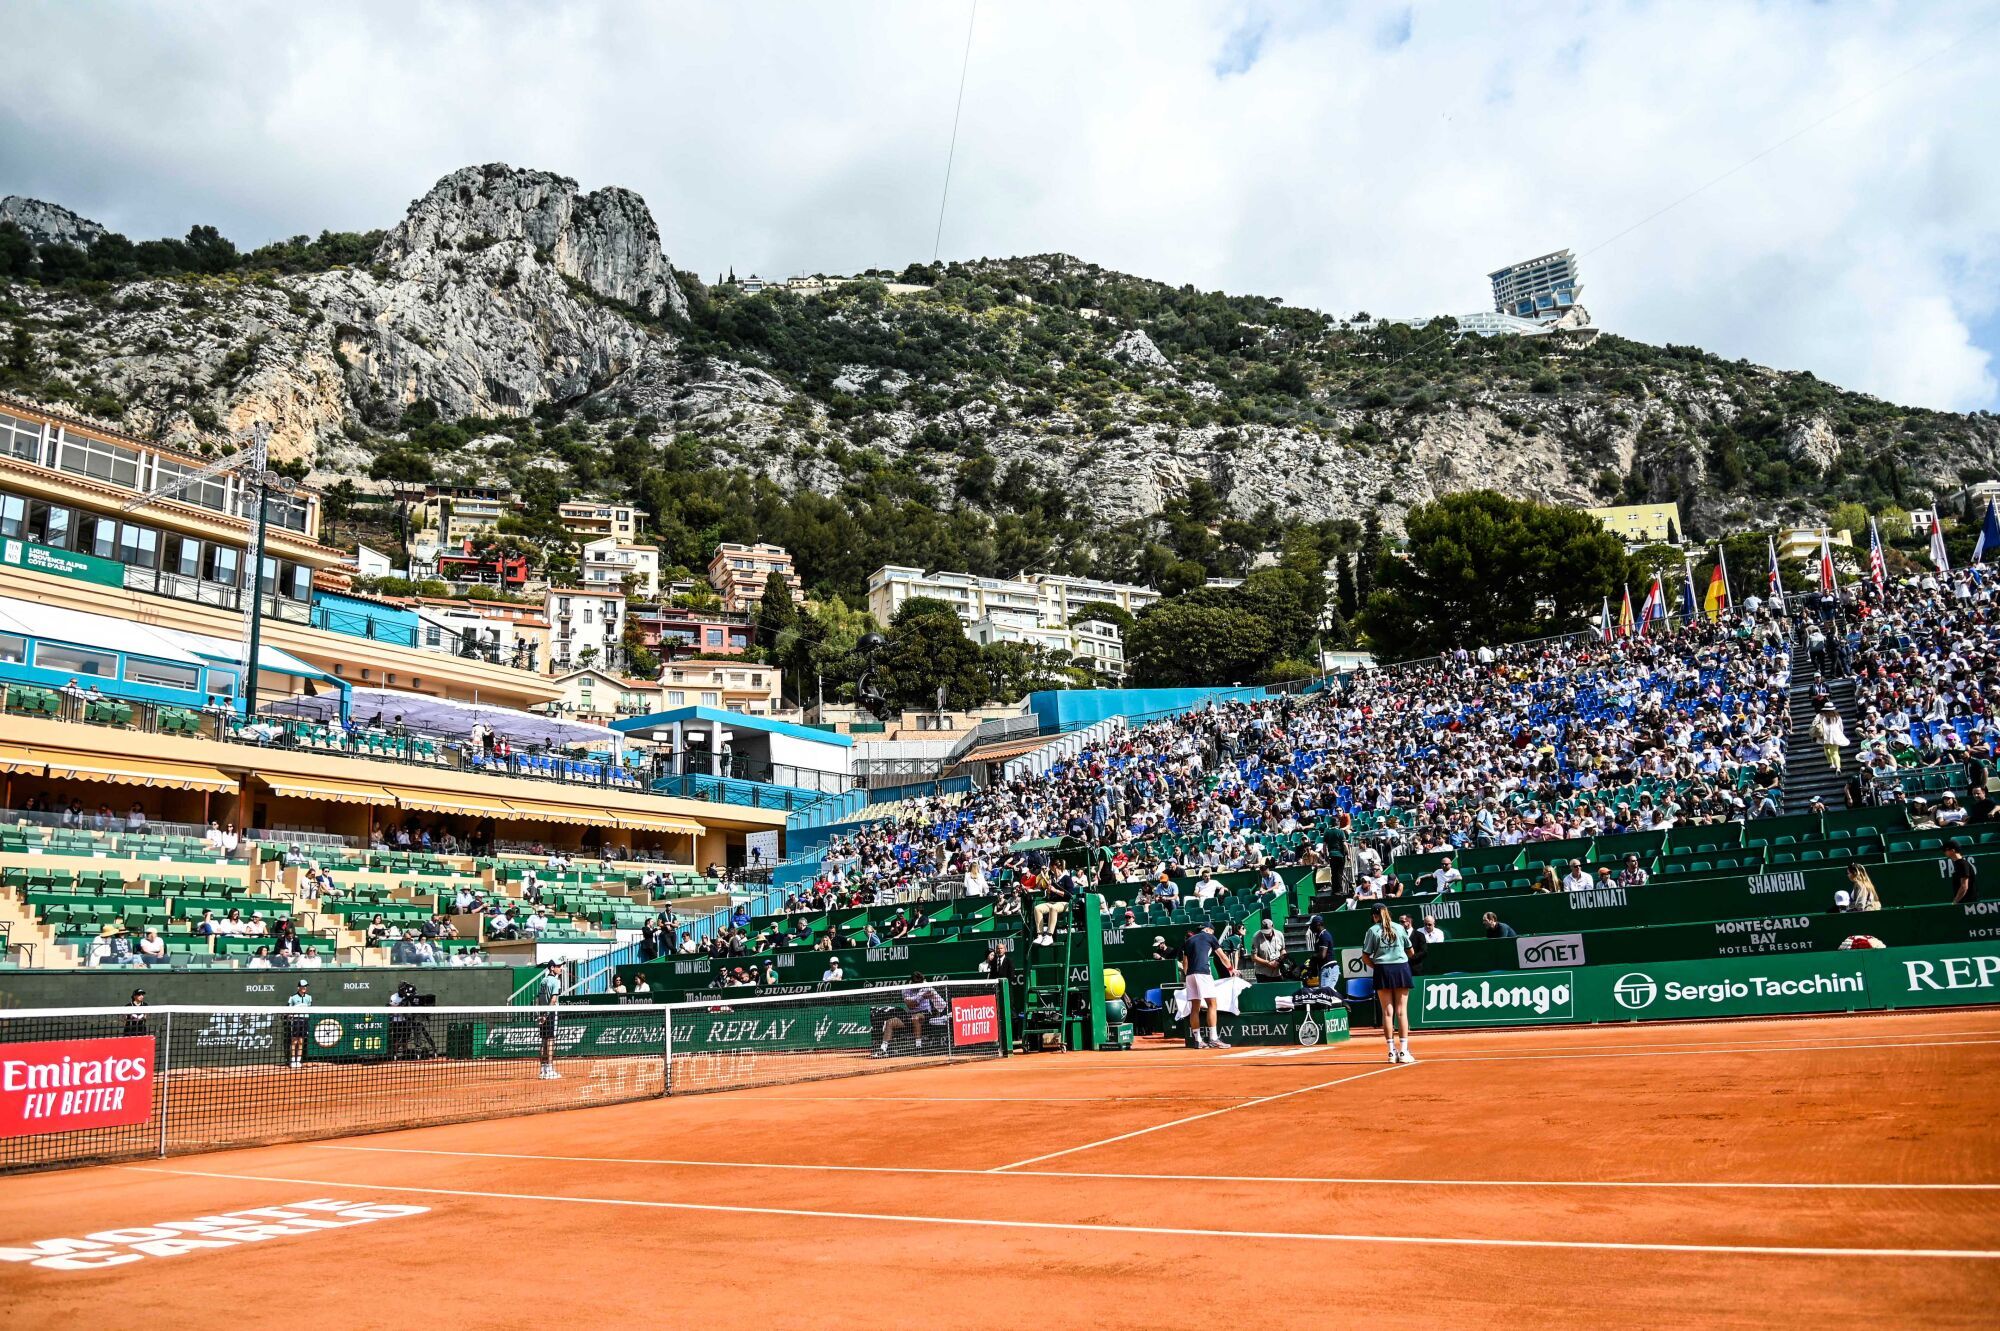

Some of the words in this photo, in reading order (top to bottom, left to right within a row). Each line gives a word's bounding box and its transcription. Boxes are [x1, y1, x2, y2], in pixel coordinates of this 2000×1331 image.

[29, 547, 50, 556] LIGUE
[28, 553, 65, 565] PROVENCE
[66, 560, 88, 570] ALPES
[47, 562, 73, 573] D'AZUR
[1938, 856, 1977, 879] PAS
[1747, 872, 1806, 895] SHANGHAI
[1569, 889, 1628, 910] CINCINNATI
[1419, 901, 1462, 920] TORONTO
[1964, 901, 2000, 916] MON
[1715, 916, 1810, 934] MONTE-CARLO
[1103, 929, 1125, 945] ROME
[1750, 932, 1777, 945] BAY
[866, 945, 909, 962] MONTE-CARLO
[1719, 945, 1754, 955] HOTEL
[1758, 944, 1765, 952] &
[1769, 941, 1813, 951] RESORT
[675, 961, 692, 974] INDIAN
[693, 960, 711, 973] WELLS
[777, 954, 795, 968] MIAMI
[1902, 955, 2000, 992] REP
[246, 984, 275, 992] ROLEX
[763, 985, 812, 995] DUNLOP
[1664, 979, 1748, 1002] Sergio
[1749, 971, 1864, 996] Tacchini
[1425, 980, 1570, 1015] Malongo
[954, 1005, 995, 1023] Emirates
[706, 1018, 796, 1043] REPLAY
[1189, 1025, 1234, 1038] EPAY
[1241, 1023, 1289, 1037] REPLAY
[1326, 1017, 1348, 1033] REPLAY
[3, 1055, 146, 1092] Emirates
[23, 1092, 57, 1120] FLY
[60, 1086, 125, 1116] BETTER
[0, 1198, 377, 1262] MONTE
[30, 1204, 433, 1271] CARLO
